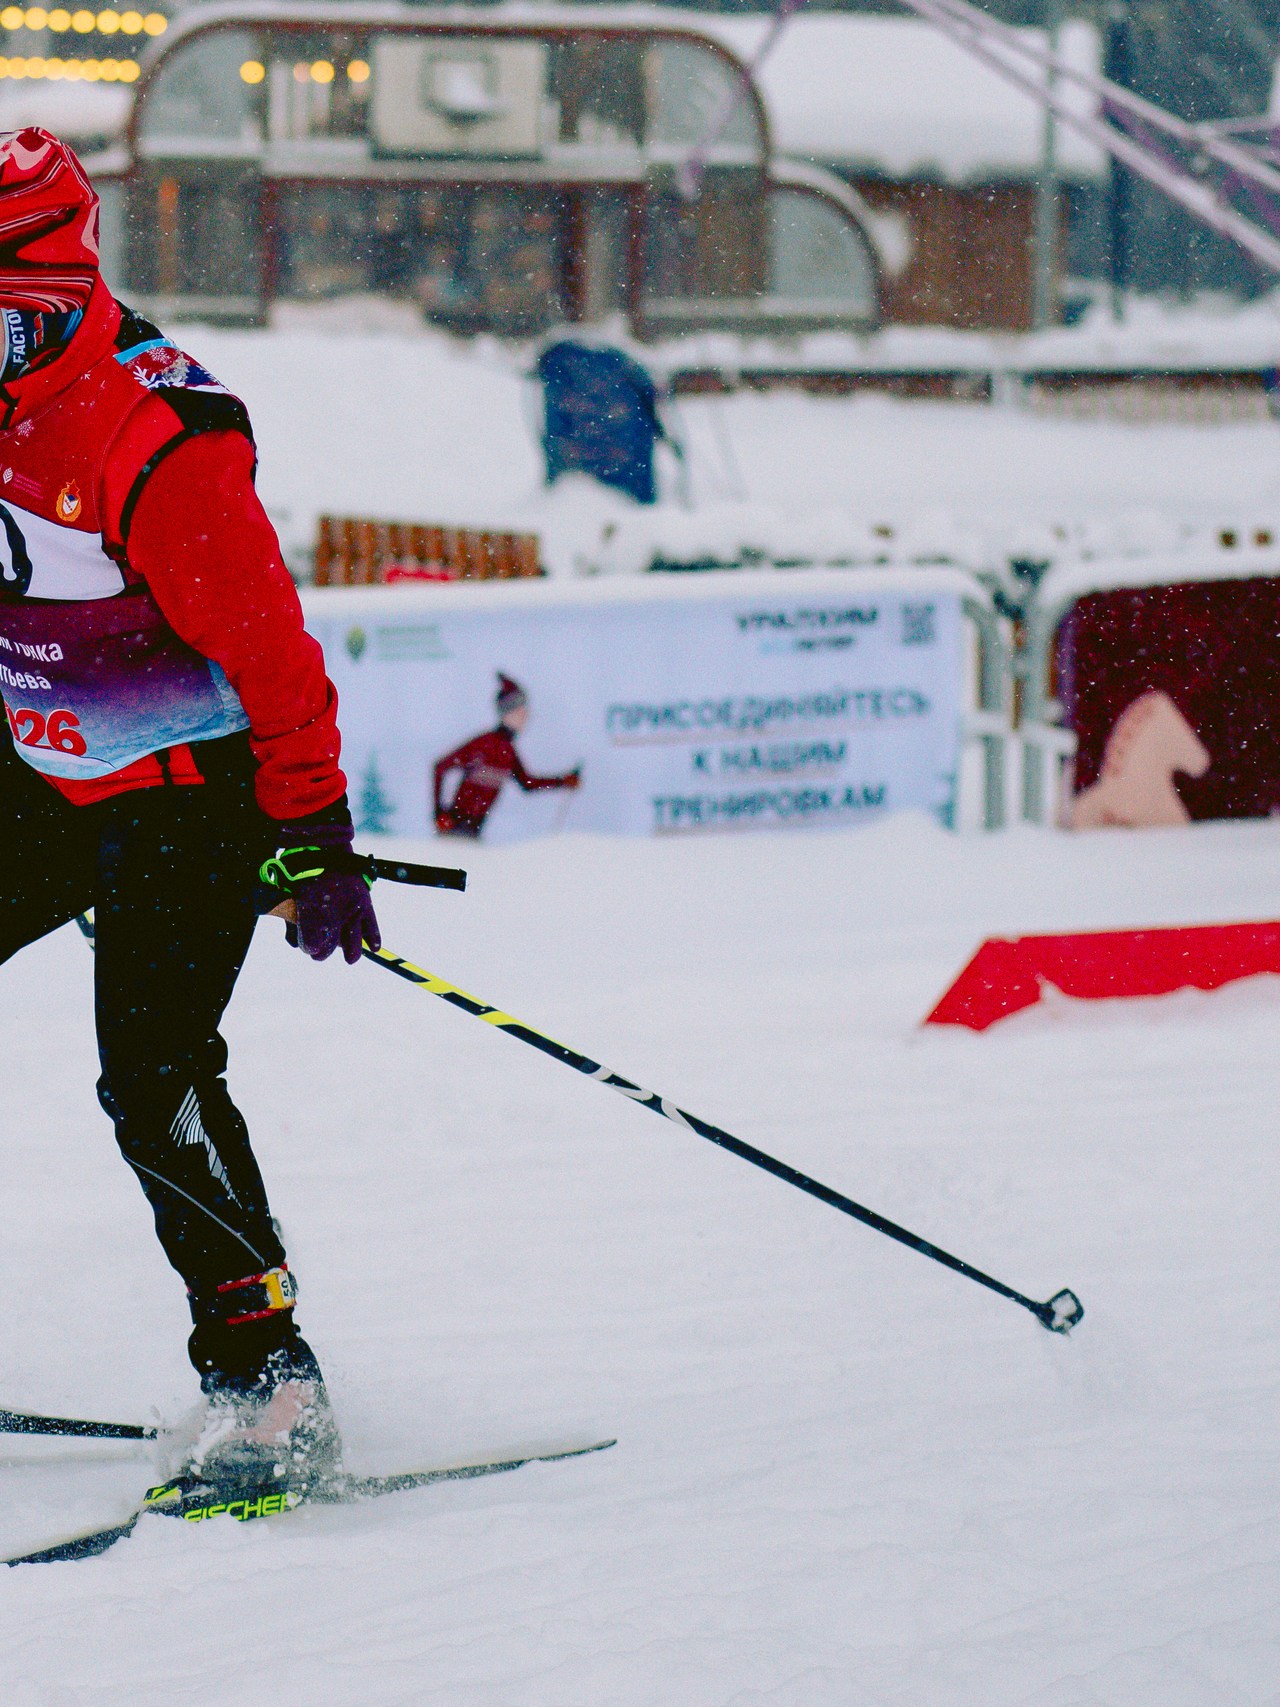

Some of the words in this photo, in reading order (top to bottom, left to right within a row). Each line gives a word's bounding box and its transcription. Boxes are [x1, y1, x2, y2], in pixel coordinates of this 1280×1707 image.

[606, 685, 930, 733] ПРИСОЕДИНЯЙТЕСЬ
[693, 750, 712, 775] К
[722, 739, 847, 773] НАШИМ
[653, 783, 887, 826] ТРЕНИРОВКАМ
